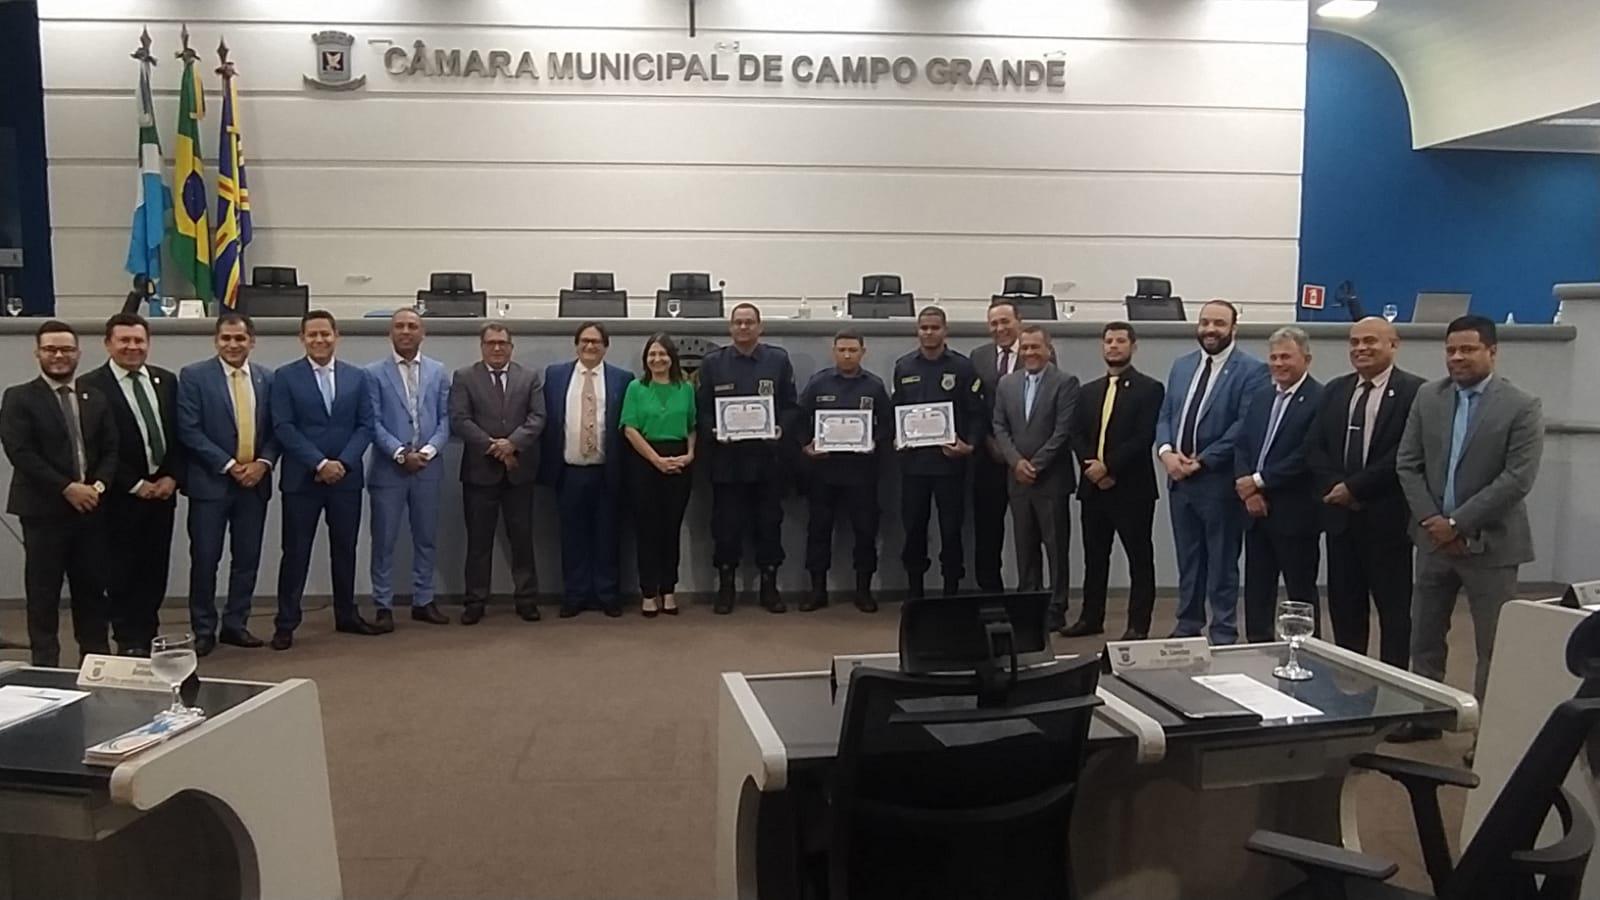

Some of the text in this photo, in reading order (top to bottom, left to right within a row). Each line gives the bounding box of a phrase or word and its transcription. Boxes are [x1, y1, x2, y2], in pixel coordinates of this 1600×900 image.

[385, 40, 1065, 88] CÂMARA MUNICIPAL DE CAMPO GRANDE
